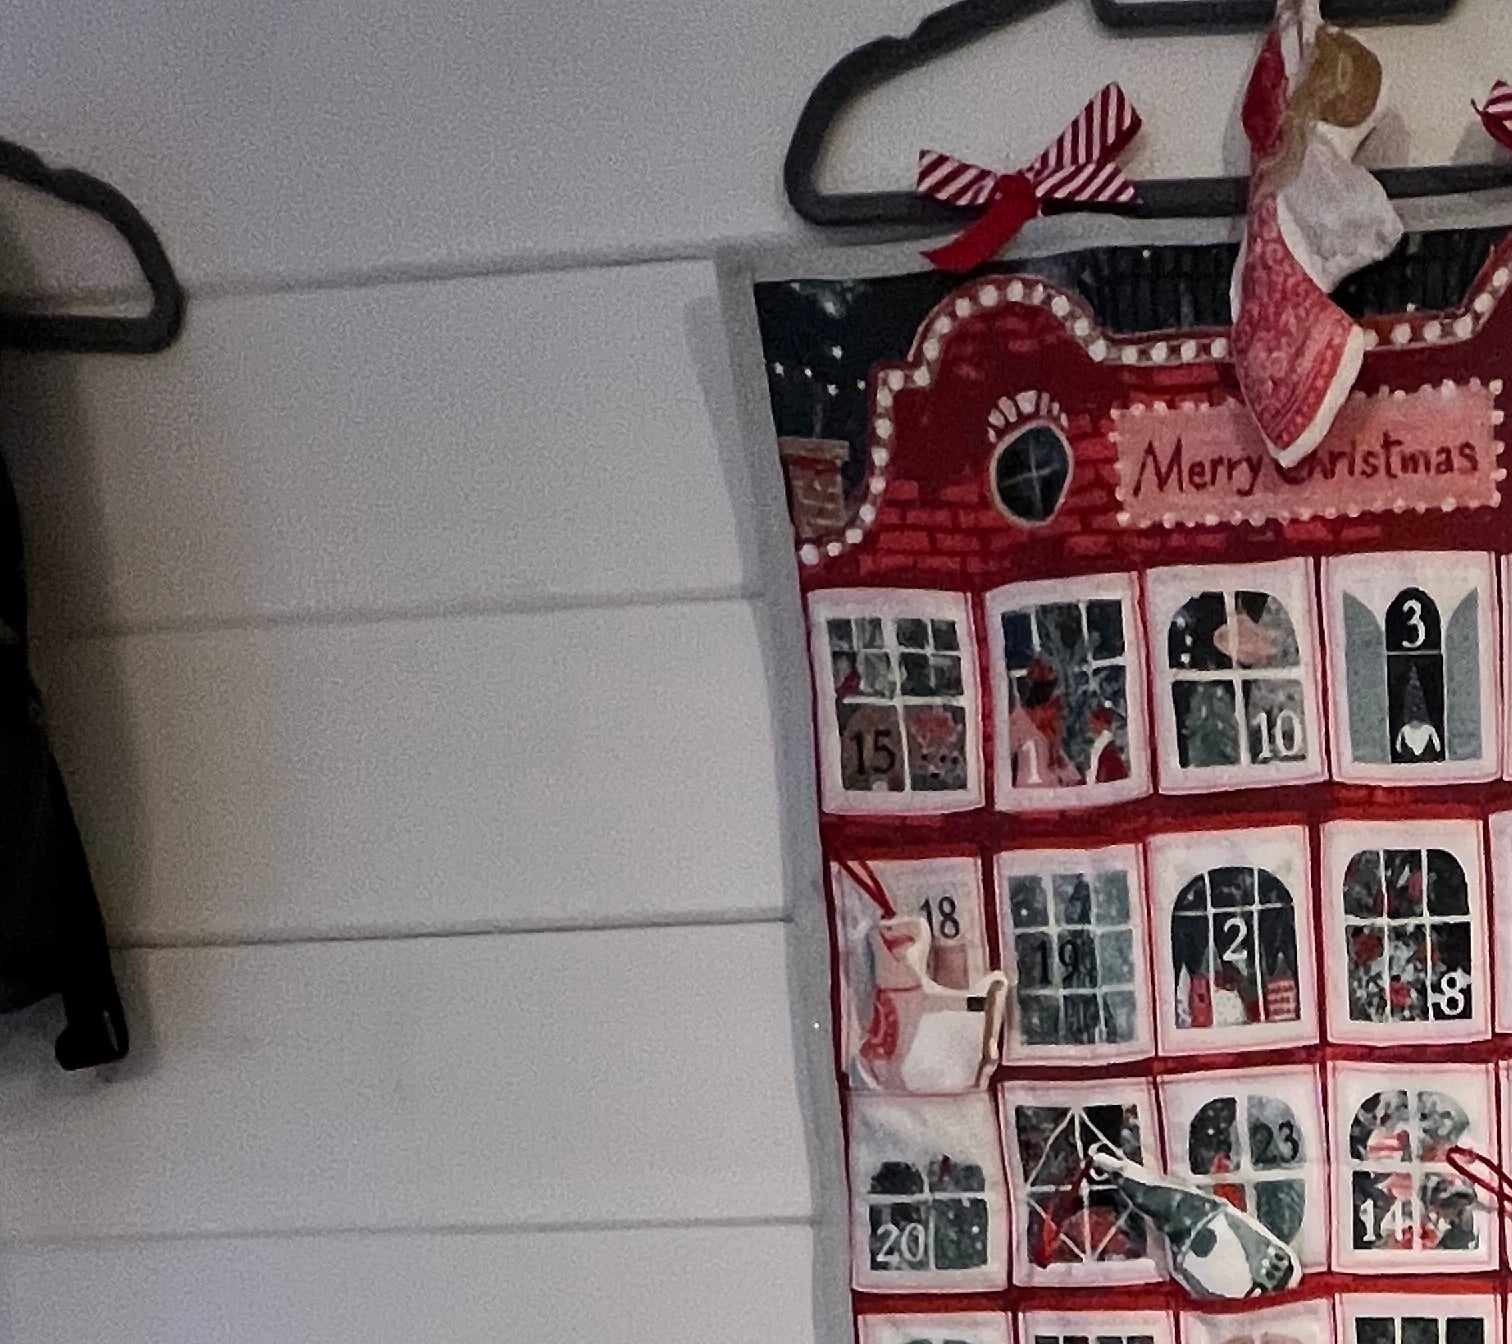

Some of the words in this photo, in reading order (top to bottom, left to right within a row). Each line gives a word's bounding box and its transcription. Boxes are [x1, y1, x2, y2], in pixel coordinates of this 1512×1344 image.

[1133, 437, 1264, 496] Merry
[1402, 600, 1427, 648] 3
[851, 728, 897, 776] 15
[1253, 709, 1303, 758] 10
[1019, 738, 1043, 785] 1
[919, 894, 961, 941] 18
[1221, 917, 1249, 962] 2
[1035, 940, 1081, 988] 19
[1438, 970, 1465, 1016] 8
[1254, 1120, 1300, 1165] 23
[876, 1222, 926, 1263] 20
[1358, 1198, 1404, 1242] 14
